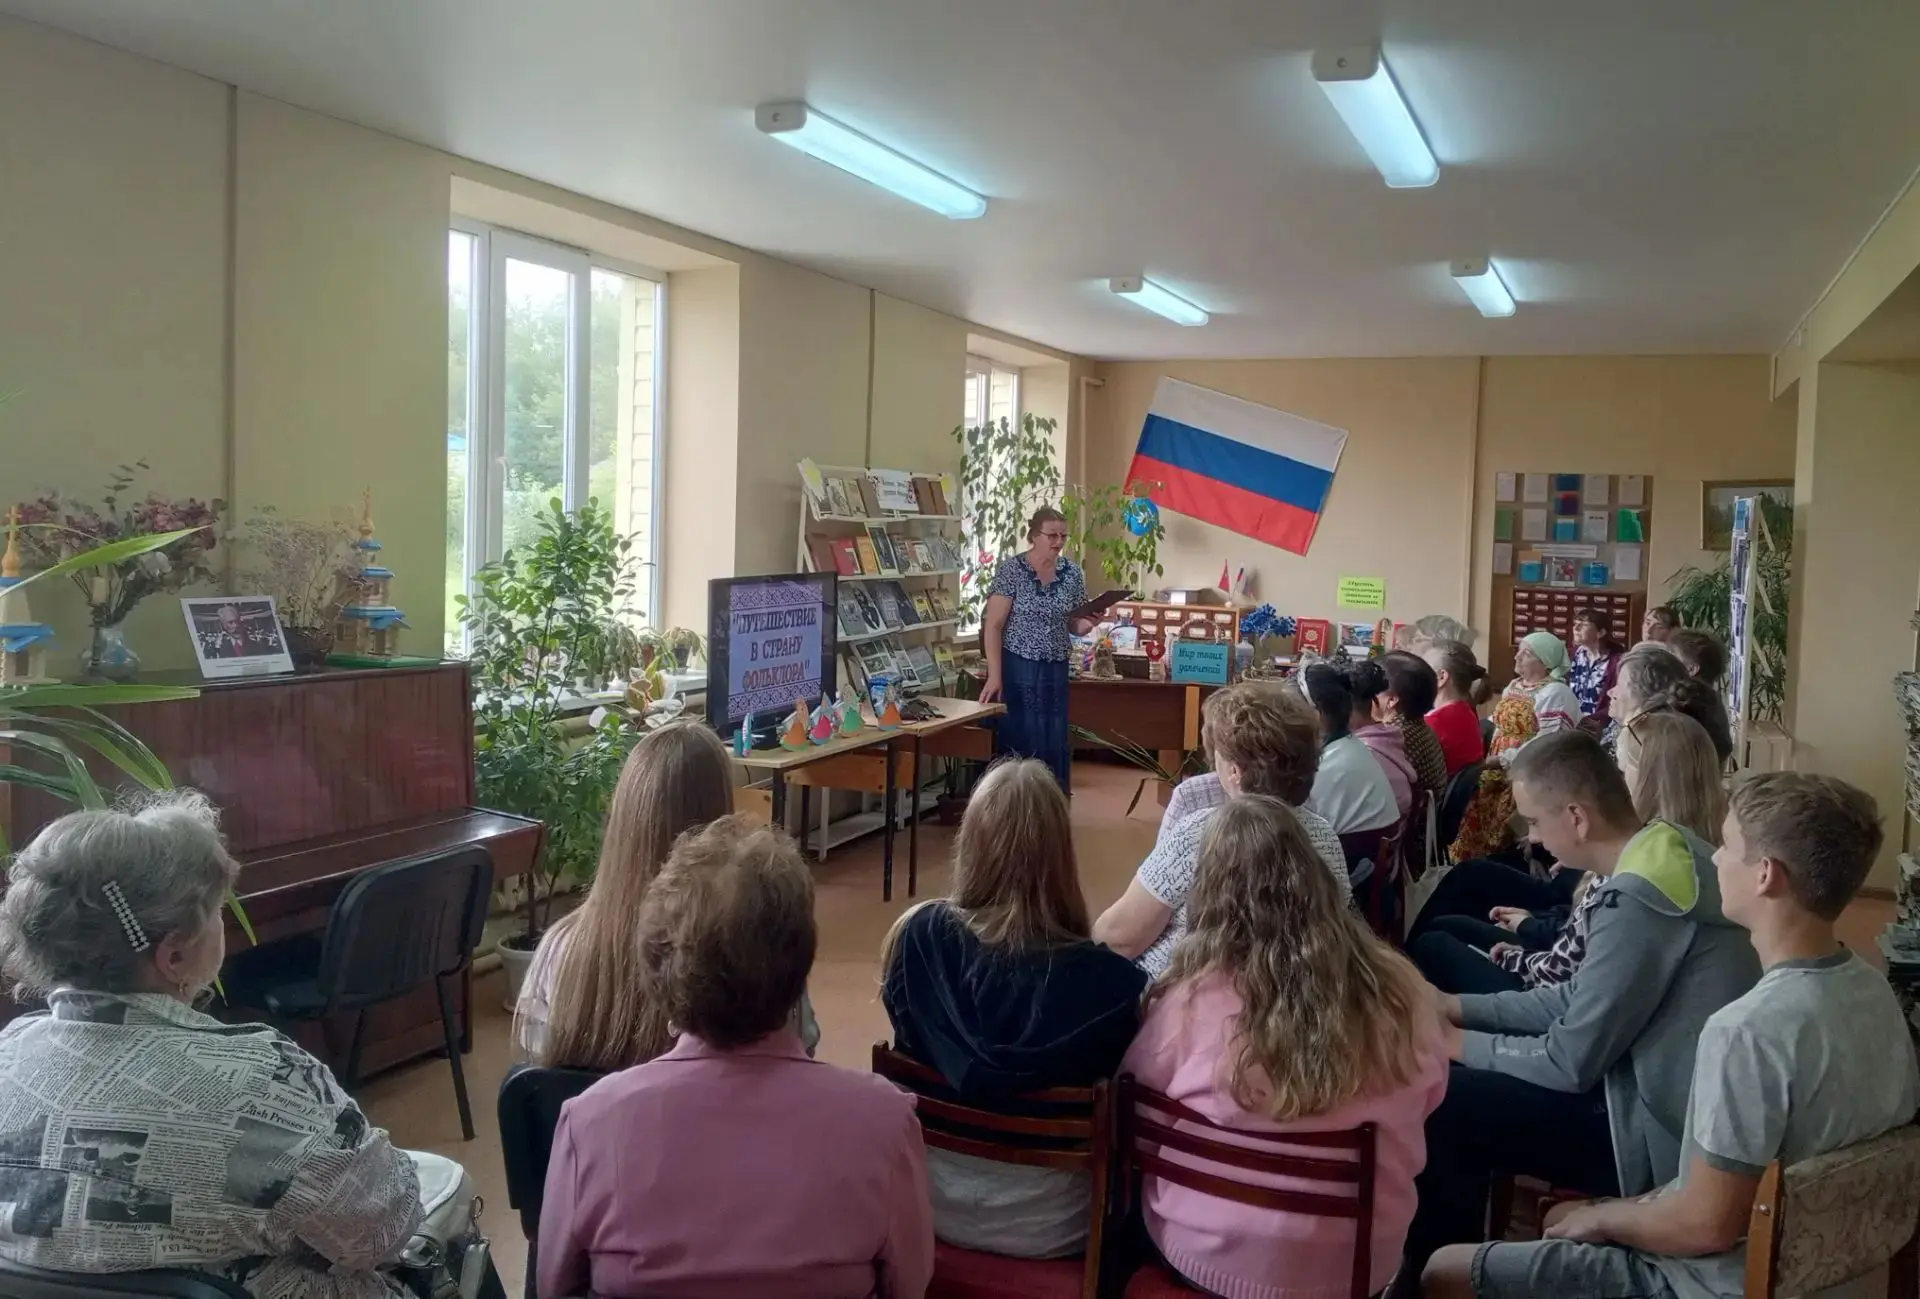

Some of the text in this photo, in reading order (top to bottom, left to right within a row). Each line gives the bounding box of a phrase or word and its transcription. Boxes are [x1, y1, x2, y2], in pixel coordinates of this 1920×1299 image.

[750, 636, 803, 661] В СТРАНУ
[743, 660, 810, 692] ФОЛЬКЛОРА"
